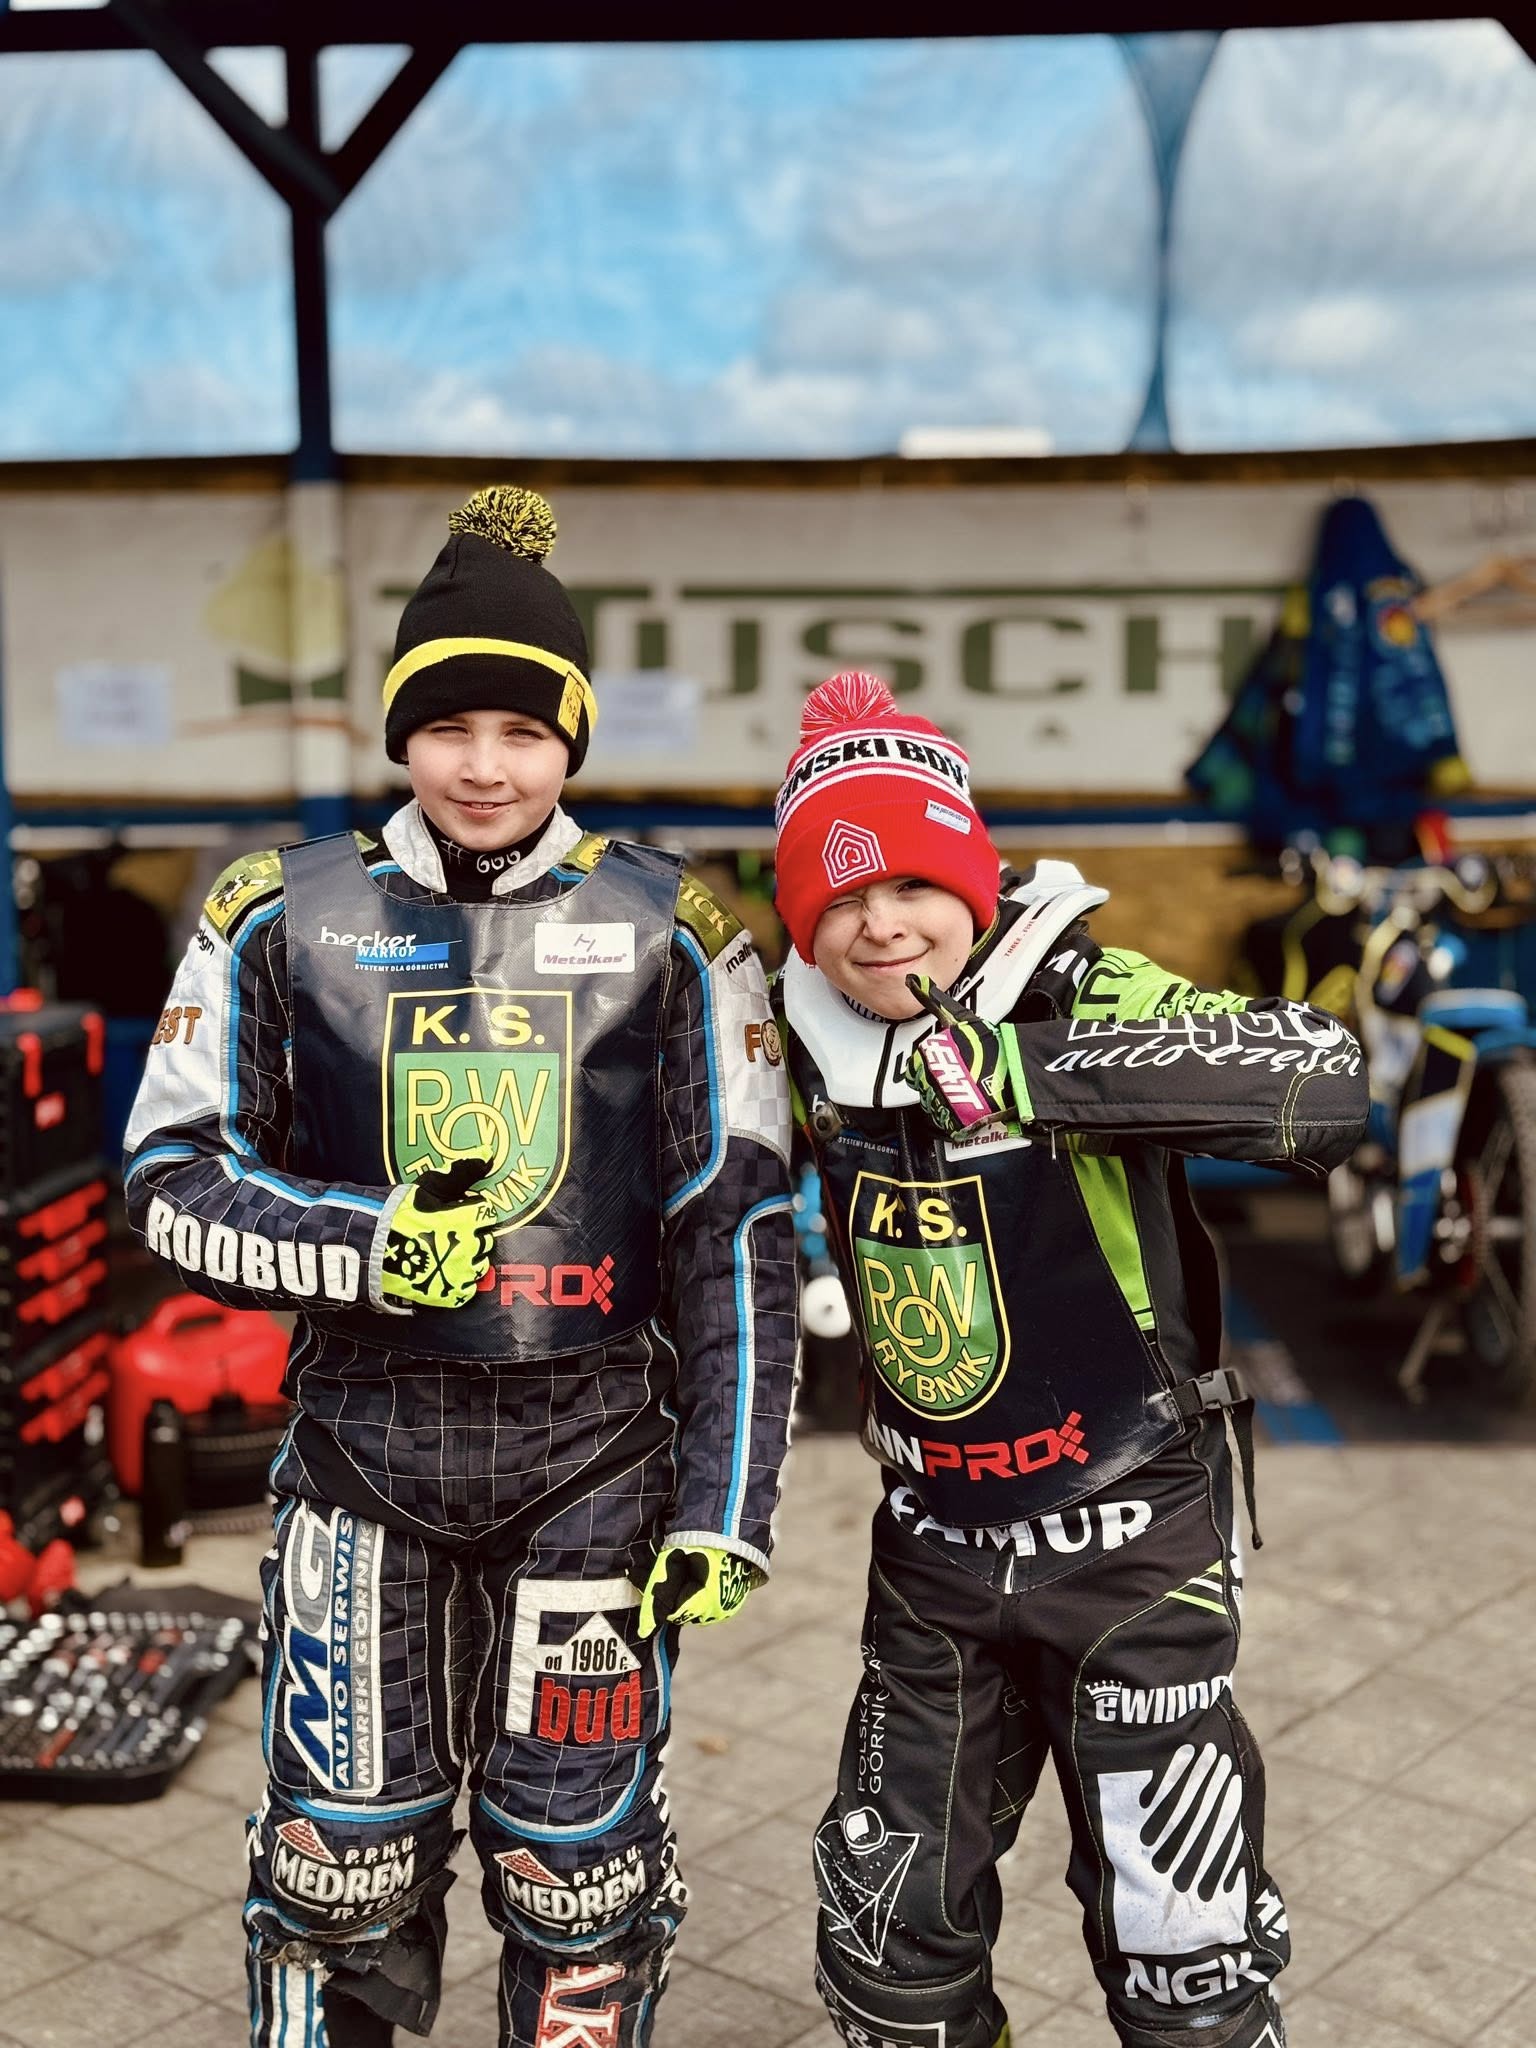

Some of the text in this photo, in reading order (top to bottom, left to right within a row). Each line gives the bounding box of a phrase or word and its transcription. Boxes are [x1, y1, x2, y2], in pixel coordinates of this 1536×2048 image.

[319, 926, 417, 948] becker
[358, 945, 417, 958] WARKOP
[390, 964, 405, 972] DLA
[148, 1196, 361, 1302] RODBUD
[874, 1339, 992, 1403] RYBNIK
[333, 1515, 354, 1788] AUTO SERWIS
[571, 1637, 618, 1672] 1986
[353, 1675, 371, 1786] MAREK
[538, 1670, 641, 1744] bud
[857, 1692, 872, 1792] POLSKA
[275, 1845, 416, 1904] MEDREM
[506, 1860, 646, 1921] MEDREM
[1124, 1951, 1270, 2005] NGK
